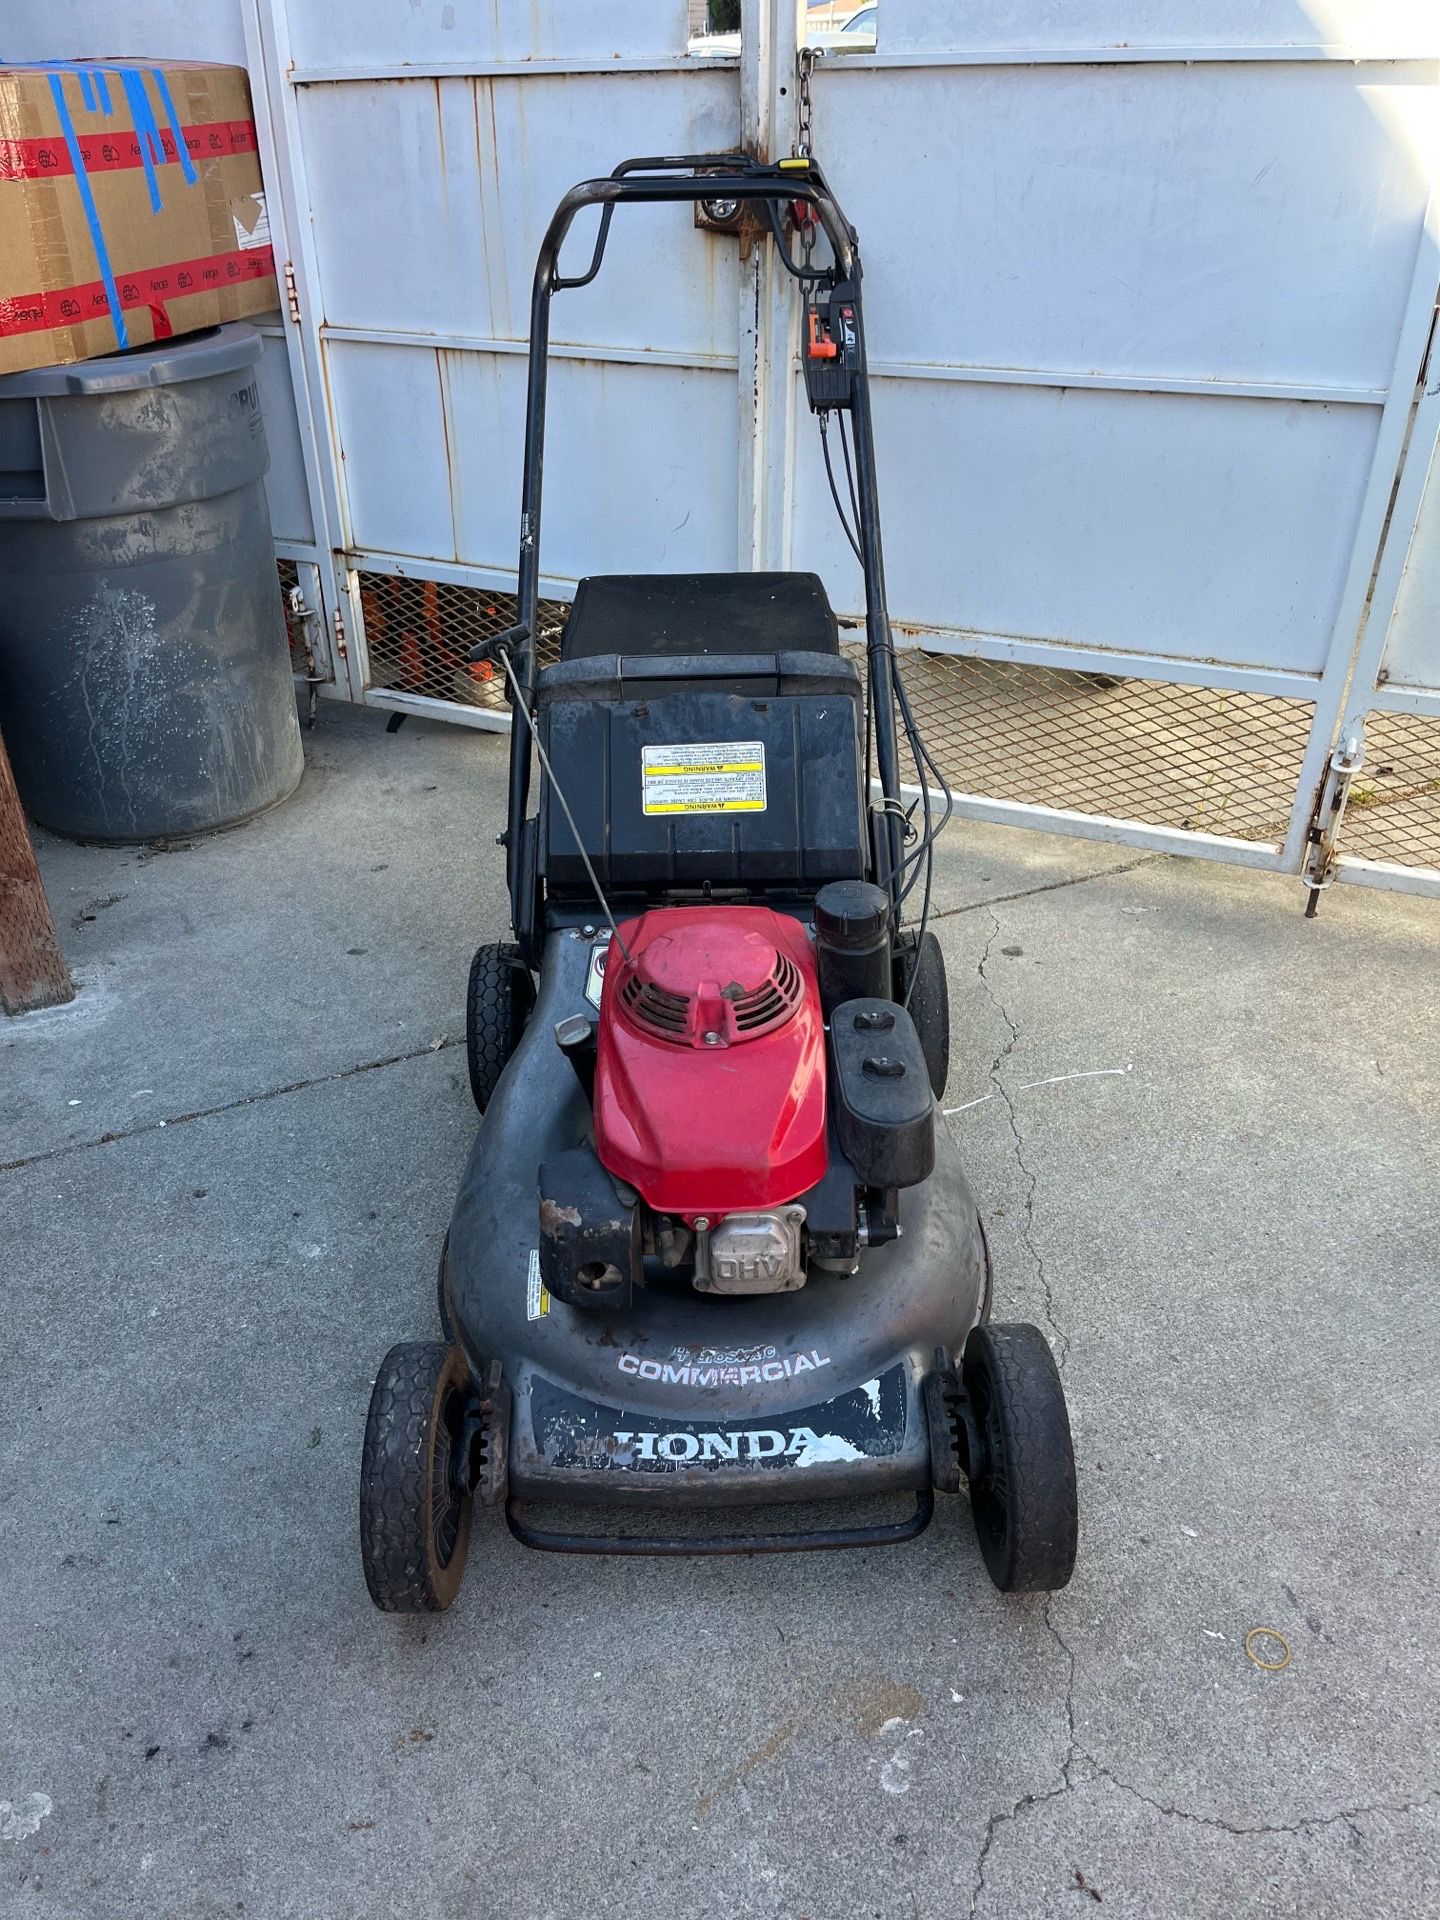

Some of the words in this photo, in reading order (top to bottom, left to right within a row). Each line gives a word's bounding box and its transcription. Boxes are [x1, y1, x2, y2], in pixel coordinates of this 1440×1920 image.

[202, 269, 219, 281] ebay
[150, 279, 169, 292] ebay
[92, 294, 109, 307] bay
[716, 1254, 783, 1280] OHV
[617, 1349, 831, 1386] COMMERCIAL
[612, 1426, 820, 1462] HONDA
